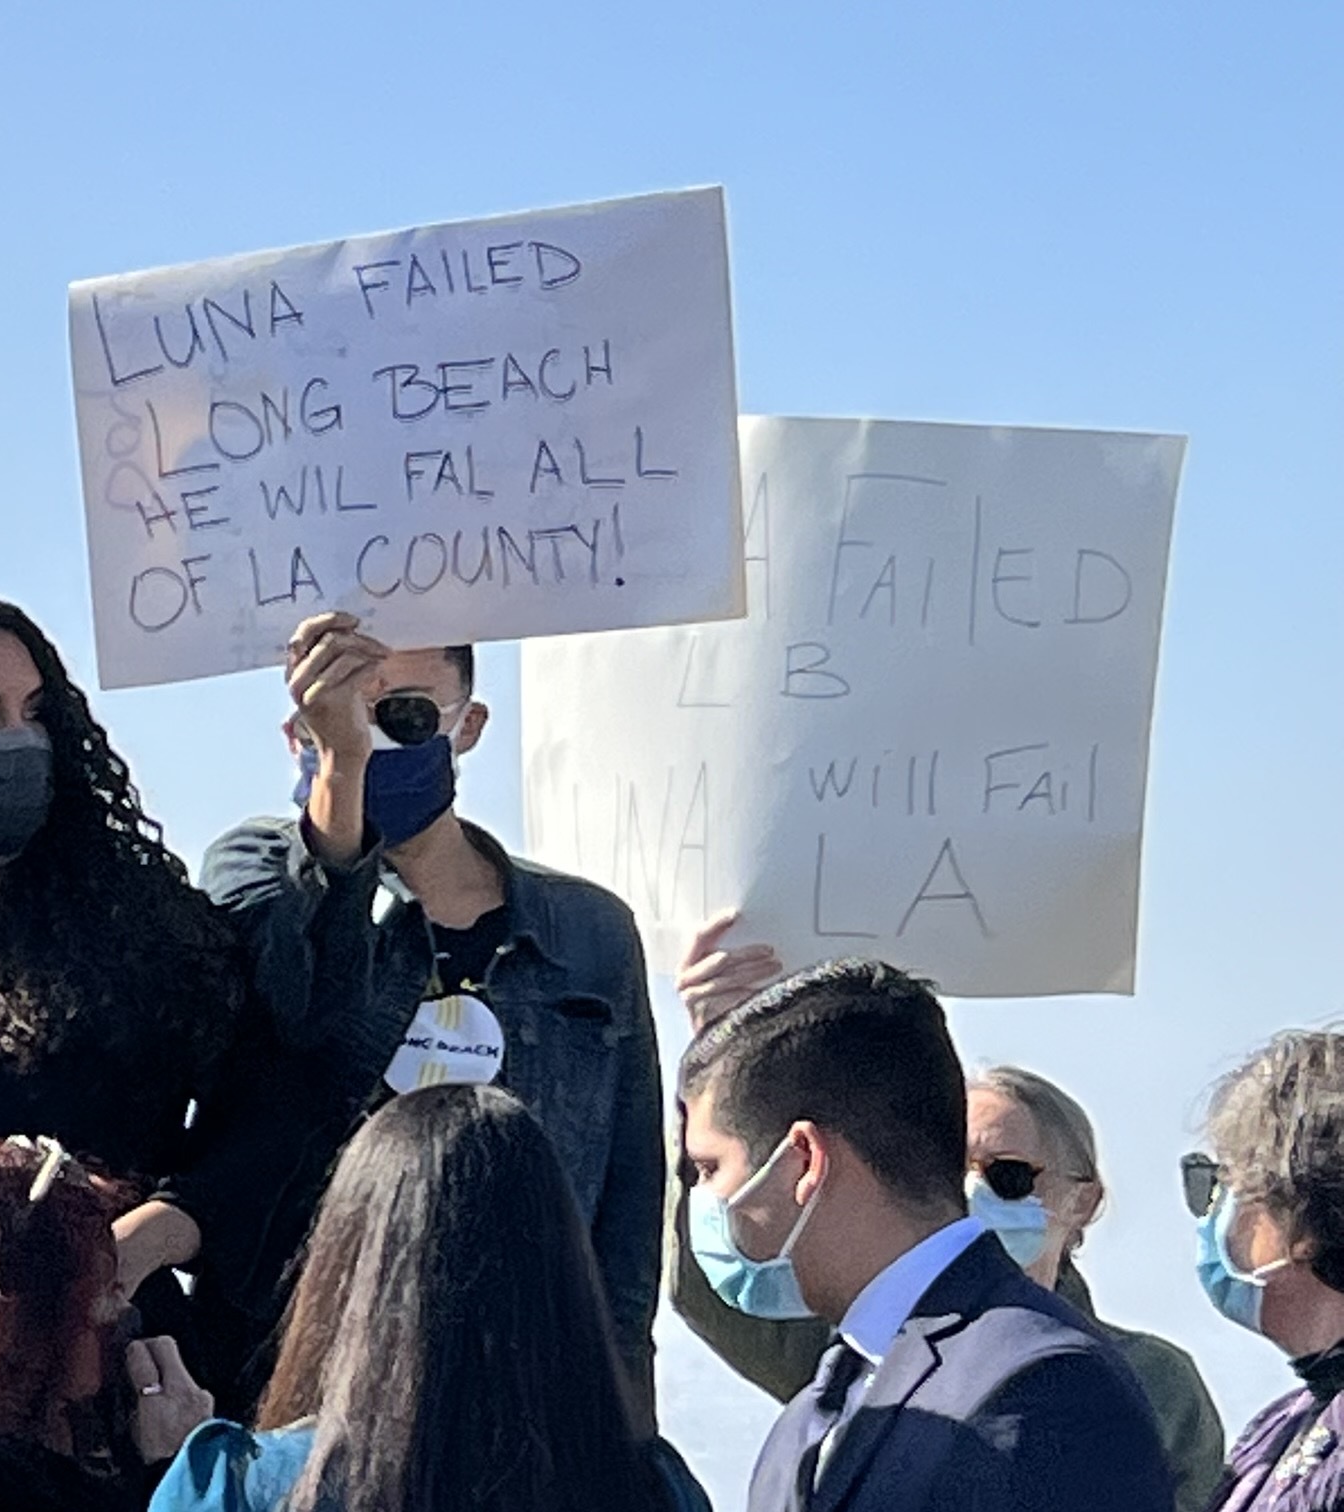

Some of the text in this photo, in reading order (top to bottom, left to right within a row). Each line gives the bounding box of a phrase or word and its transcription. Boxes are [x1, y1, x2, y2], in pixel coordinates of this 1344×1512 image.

[92, 241, 581, 386] LUNA FAILED
[146, 377, 343, 478] LONG
[372, 338, 614, 423] BEACH
[135, 425, 678, 539] HE WIL FAL ALL
[129, 502, 625, 633] OF LA COUNTY!
[780, 640, 851, 699] B
[812, 833, 996, 939] LA
